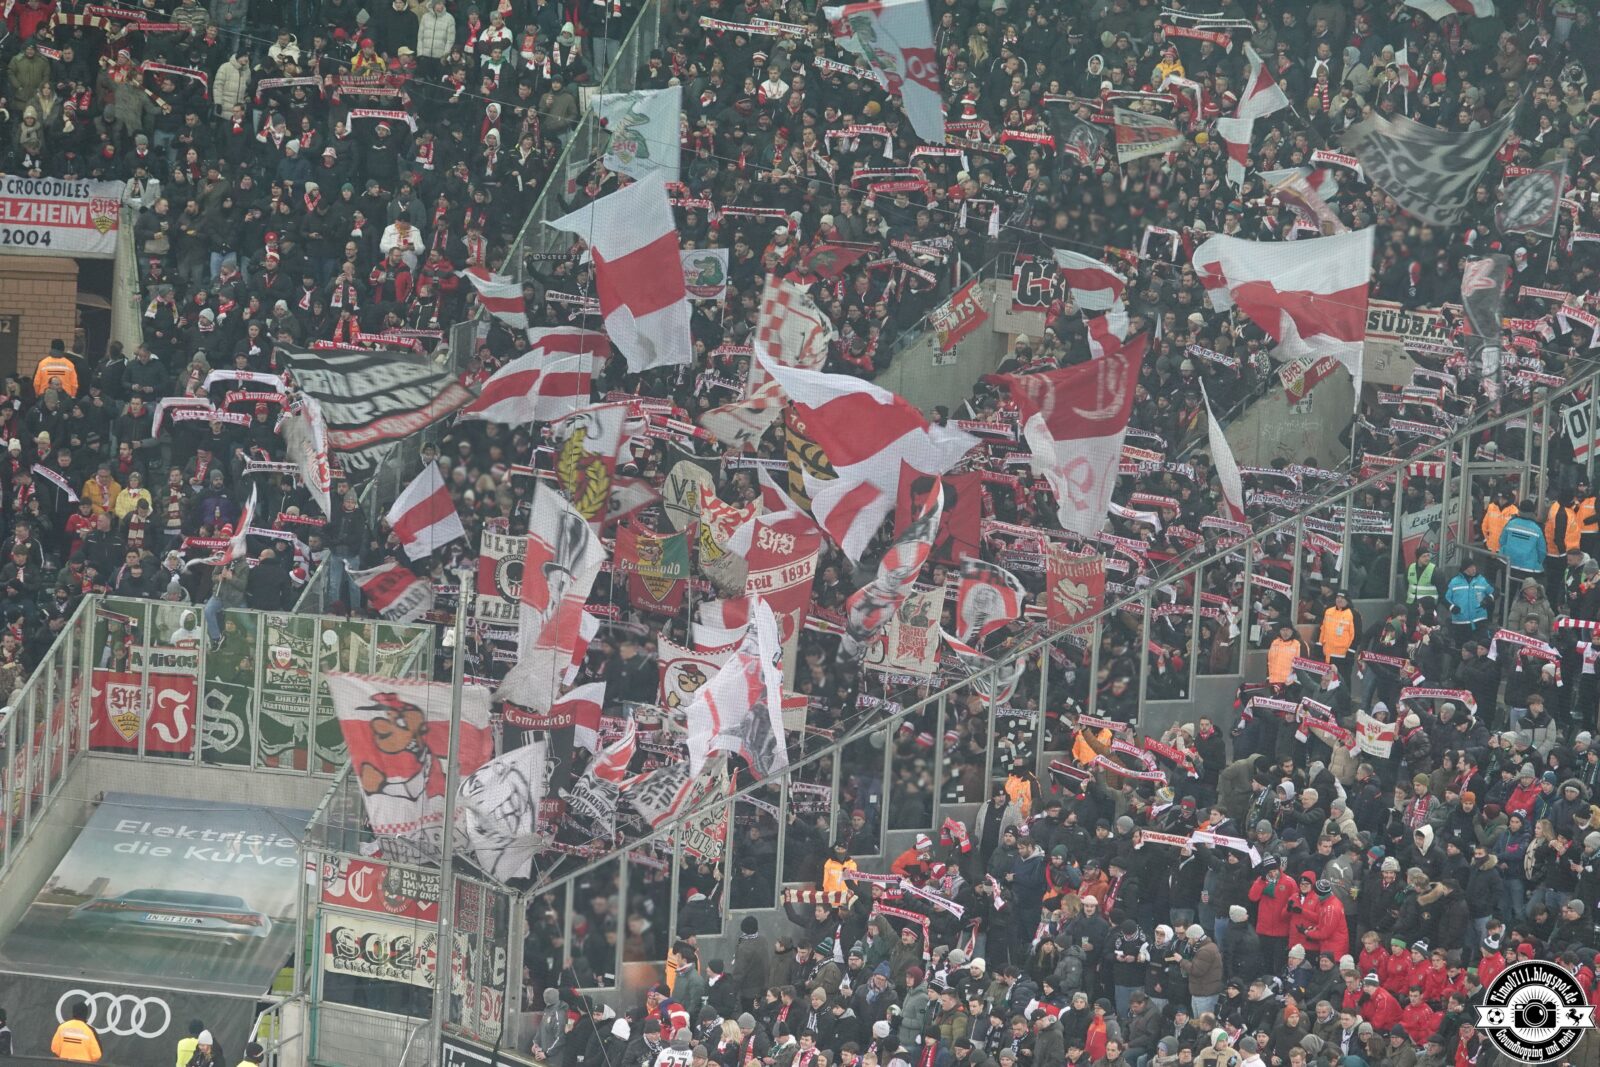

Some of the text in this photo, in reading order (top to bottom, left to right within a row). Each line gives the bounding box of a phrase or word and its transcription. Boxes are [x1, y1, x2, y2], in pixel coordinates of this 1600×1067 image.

[7, 179, 90, 199] CROCODILES
[2, 228, 51, 247] 2004
[756, 525, 797, 556] VfB
[747, 562, 812, 591] seit 1893
[1050, 561, 1105, 579] STUTTGART
[505, 710, 571, 728] Commando
[113, 840, 298, 867] die Kurve
[403, 882, 440, 895] IMMER
